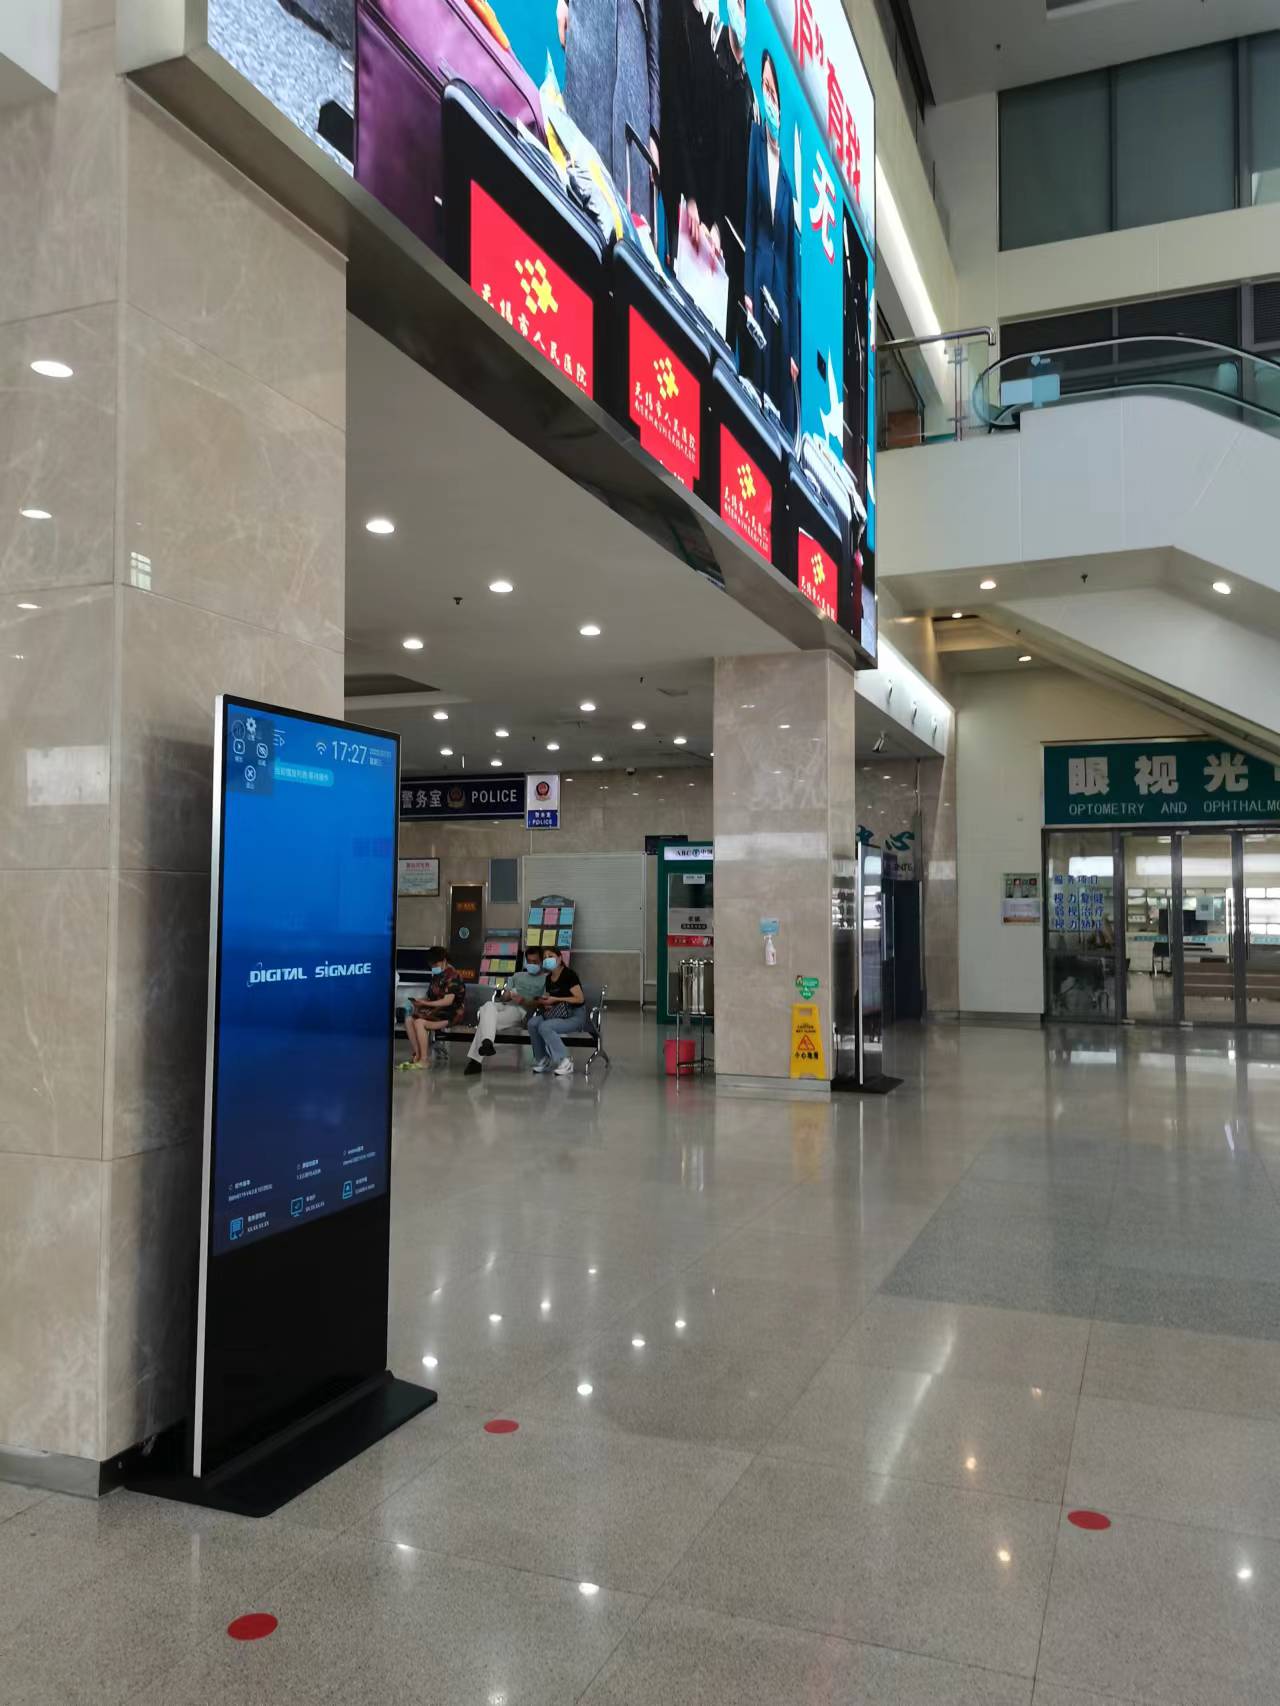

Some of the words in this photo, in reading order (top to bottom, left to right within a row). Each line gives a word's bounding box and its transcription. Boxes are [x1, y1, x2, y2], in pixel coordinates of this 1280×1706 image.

[332, 740, 368, 765] 17:27
[1068, 752, 1280, 796] 眼视光
[401, 790, 442, 809] 警务室
[471, 789, 518, 803] POLICE
[1069, 802, 1145, 816] OPTOMETRY
[1161, 801, 1187, 814] AND
[249, 967, 308, 984] DIGITAL
